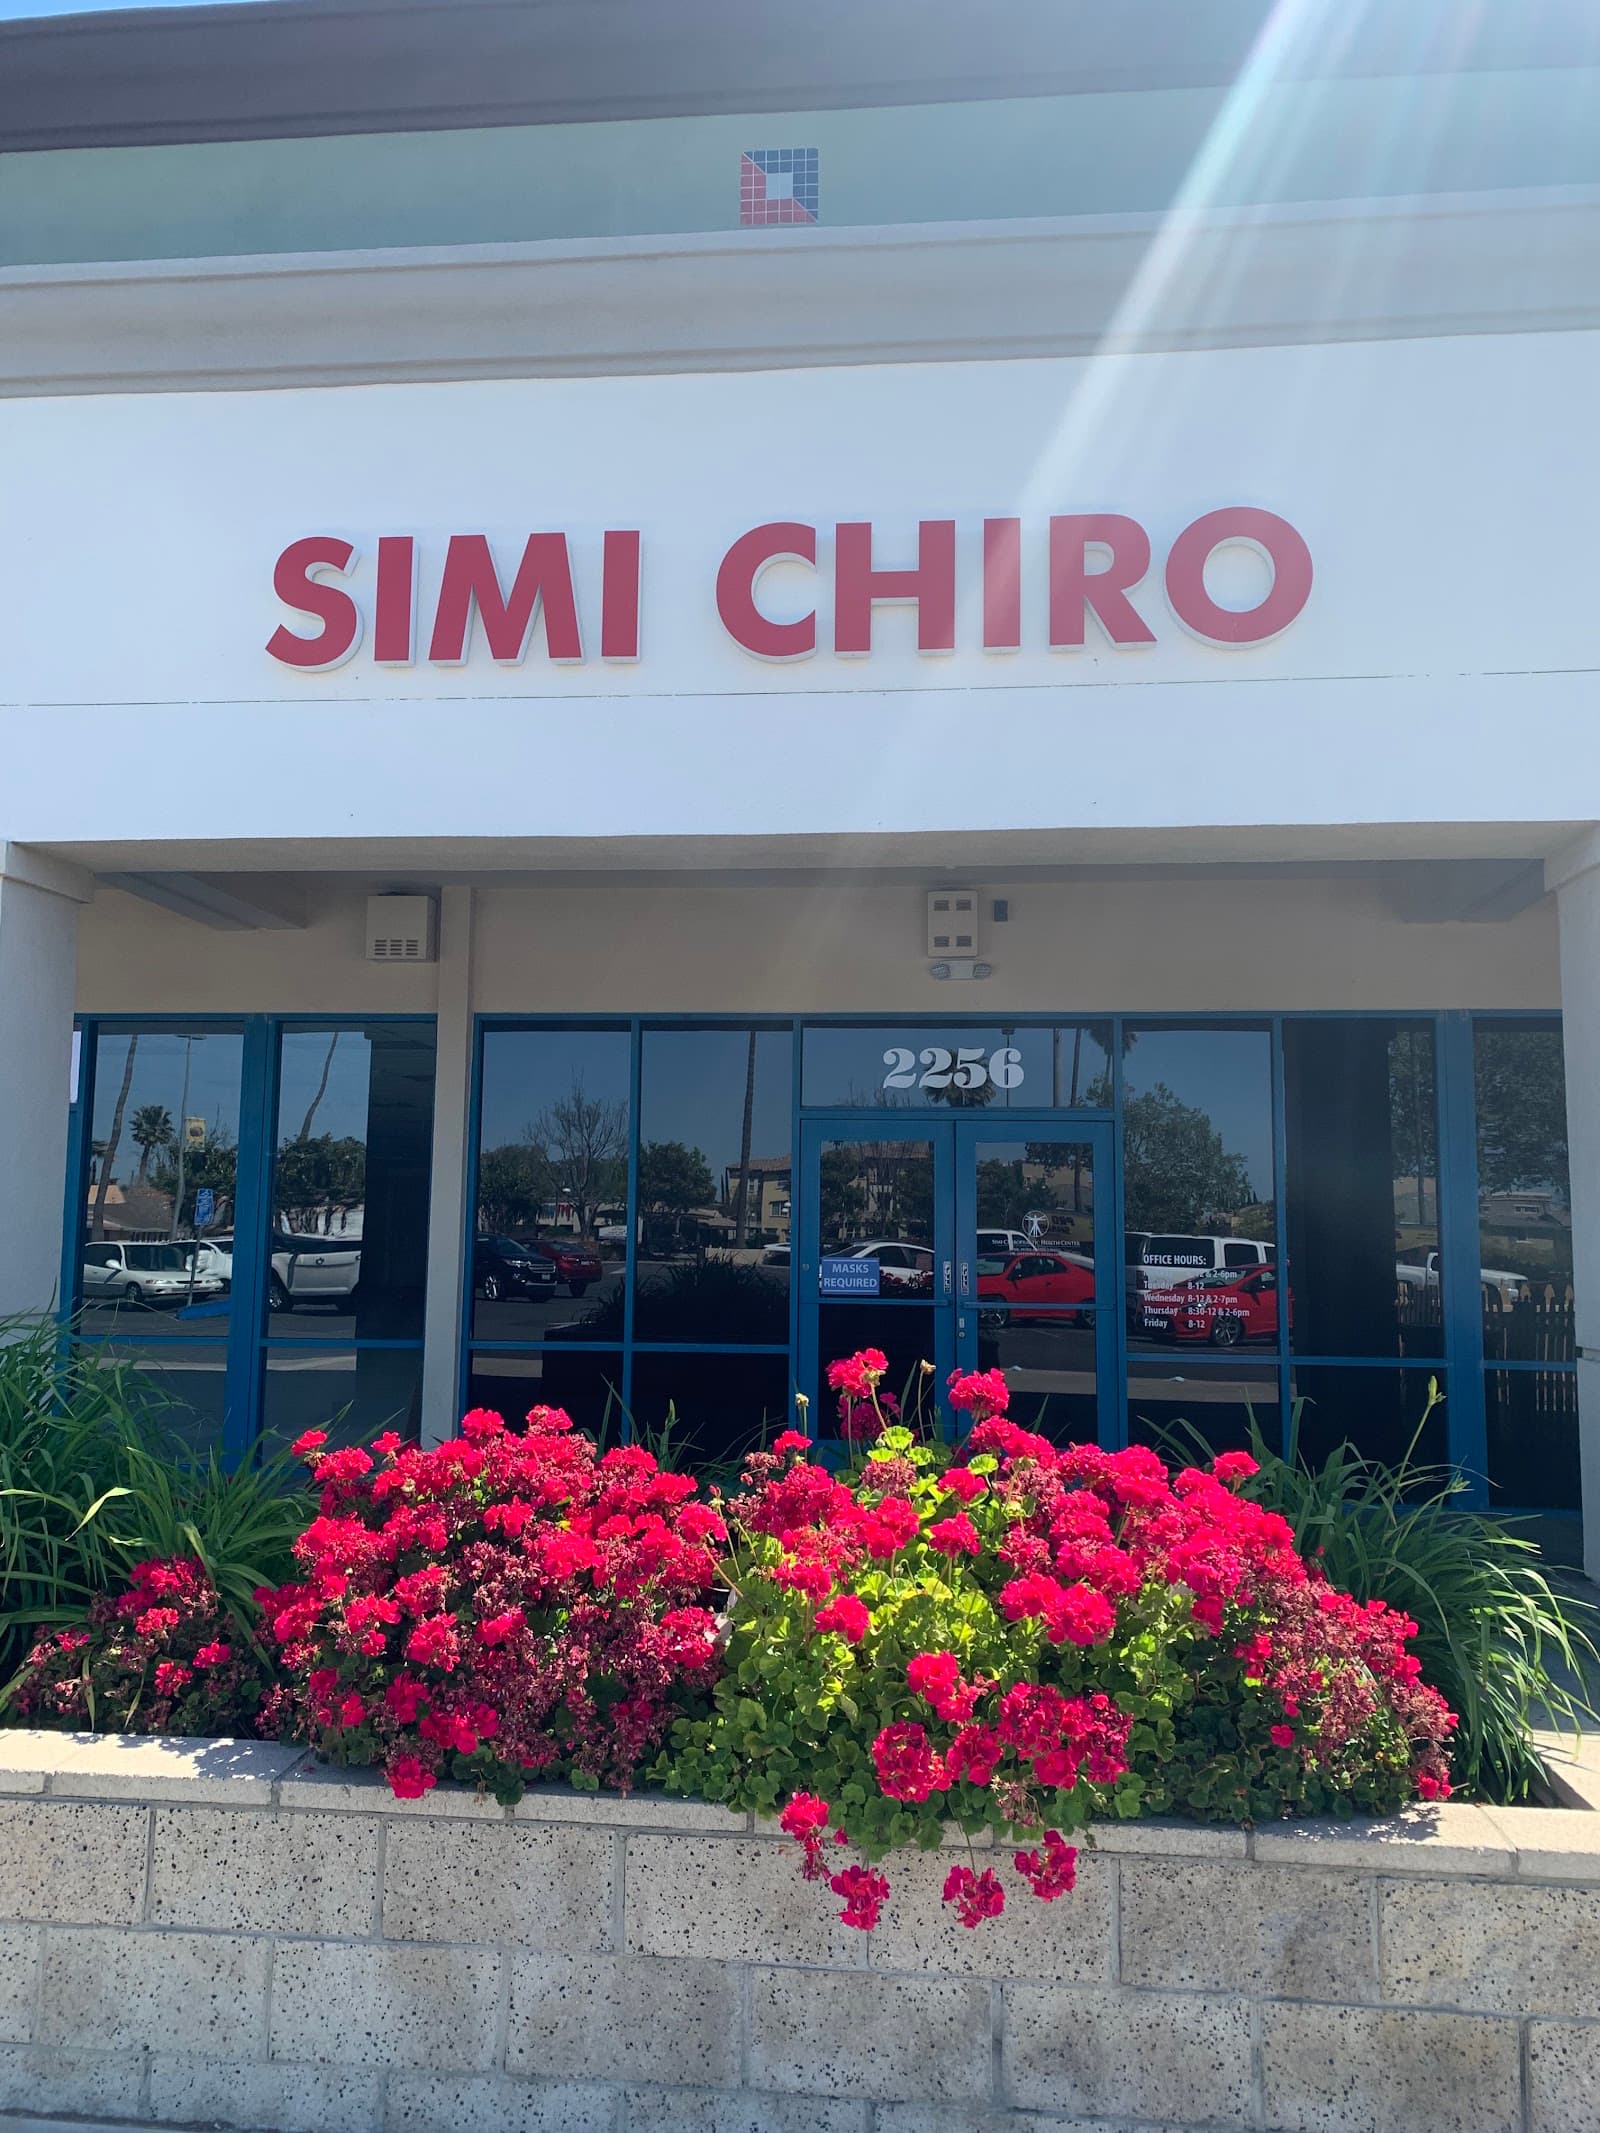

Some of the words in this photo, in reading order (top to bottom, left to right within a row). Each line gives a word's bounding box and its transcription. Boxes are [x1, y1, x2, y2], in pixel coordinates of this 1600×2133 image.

[265, 530, 642, 672] SIMI
[716, 506, 1313, 663] CHIRO
[882, 1047, 1025, 1089] 2256
[1143, 1254, 1172, 1265] OFFICE
[1173, 1255, 1207, 1265] HOURS:
[832, 1263, 869, 1274] MASKS
[1213, 1270, 1238, 1279] 2-6pm
[823, 1277, 878, 1288] REQUIRED
[1187, 1281, 1205, 1290] 8-12
[1143, 1294, 1185, 1304] Wednesday
[1187, 1295, 1205, 1303] 8-12
[1213, 1295, 1238, 1305] 2-7pm
[1144, 1306, 1178, 1316] Thursday
[1188, 1307, 1216, 1316] 8:30-12
[1225, 1308, 1250, 1318] 2-6pm
[1145, 1318, 1168, 1329] Friday
[1188, 1319, 1206, 1329] 8-12
